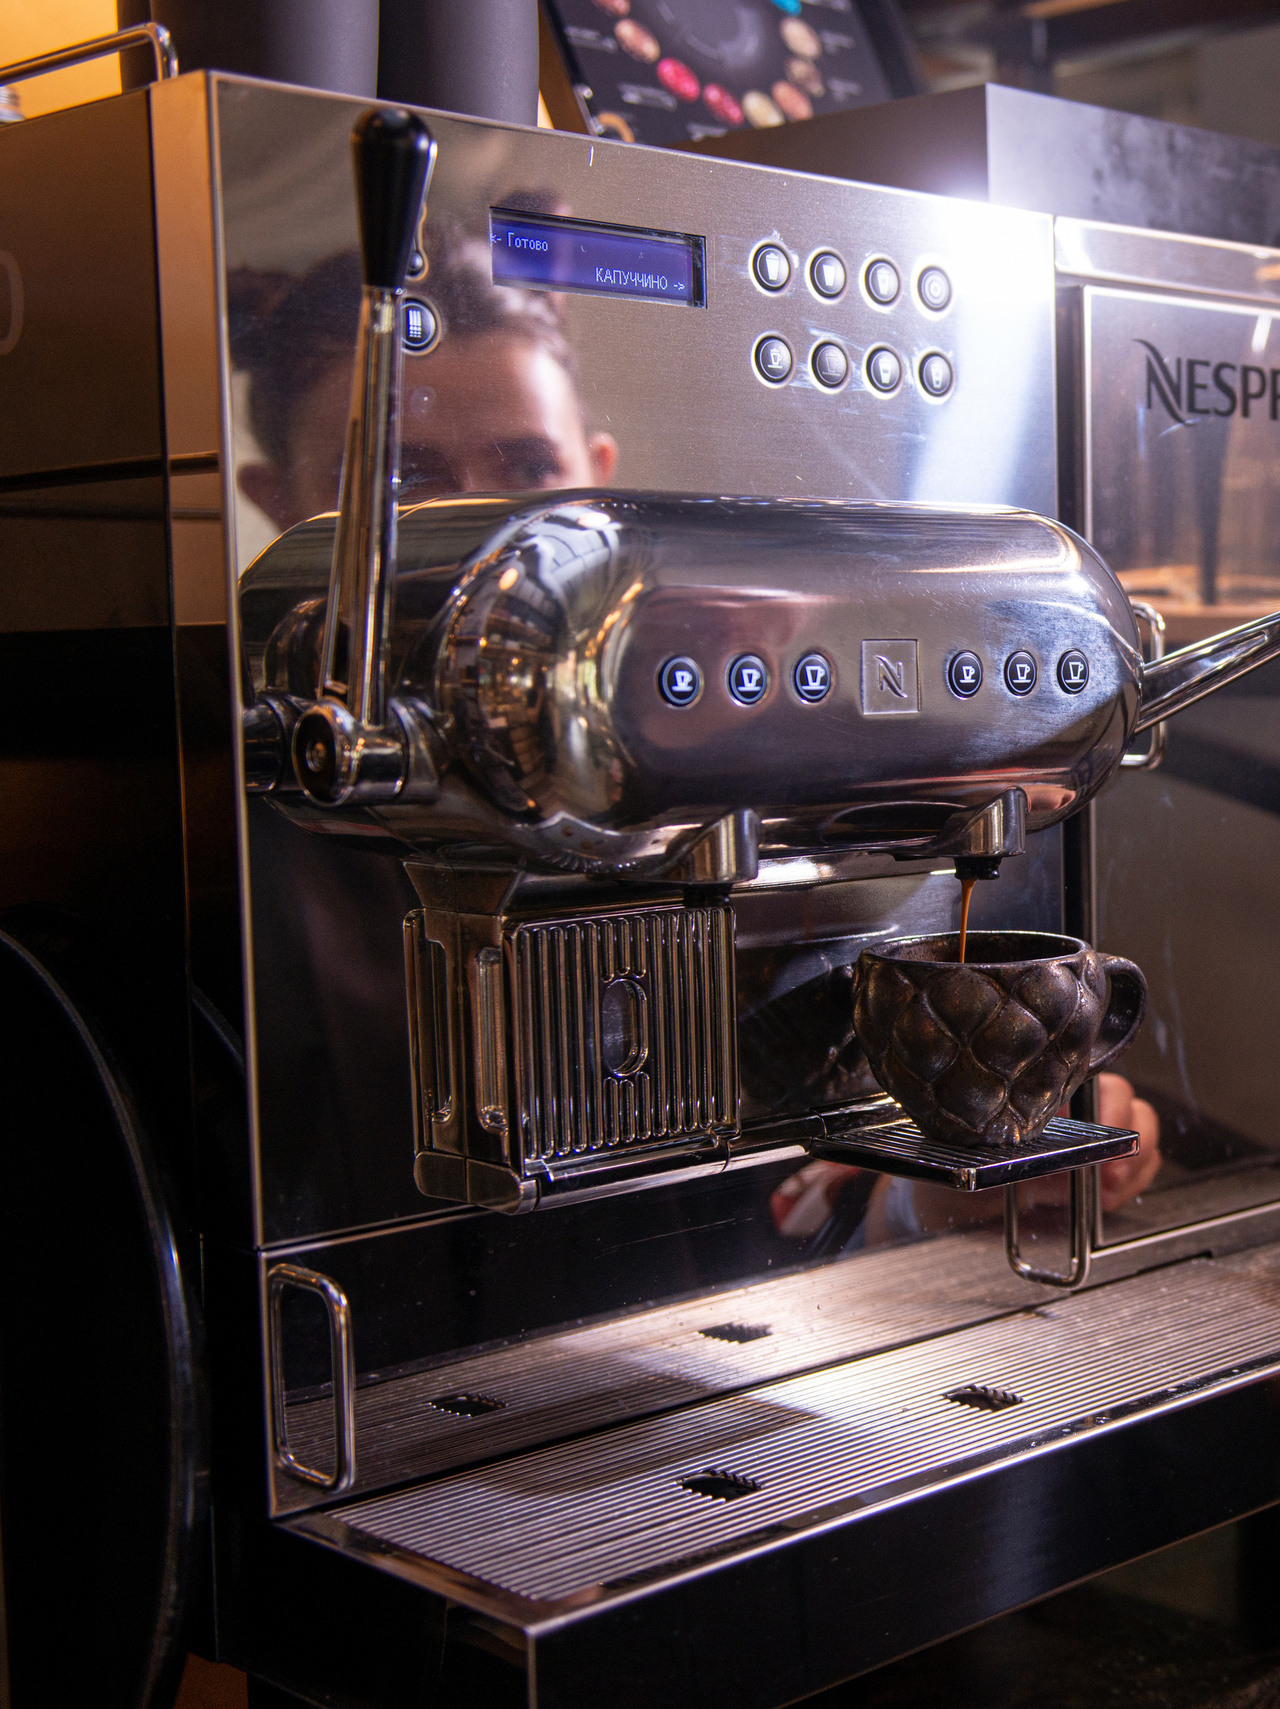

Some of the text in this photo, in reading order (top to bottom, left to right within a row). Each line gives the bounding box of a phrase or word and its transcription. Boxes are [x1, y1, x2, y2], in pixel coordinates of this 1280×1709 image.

[507, 231, 548, 251] Готово
[595, 267, 668, 290] КАПУЧЧИНО
[875, 654, 908, 699] N
